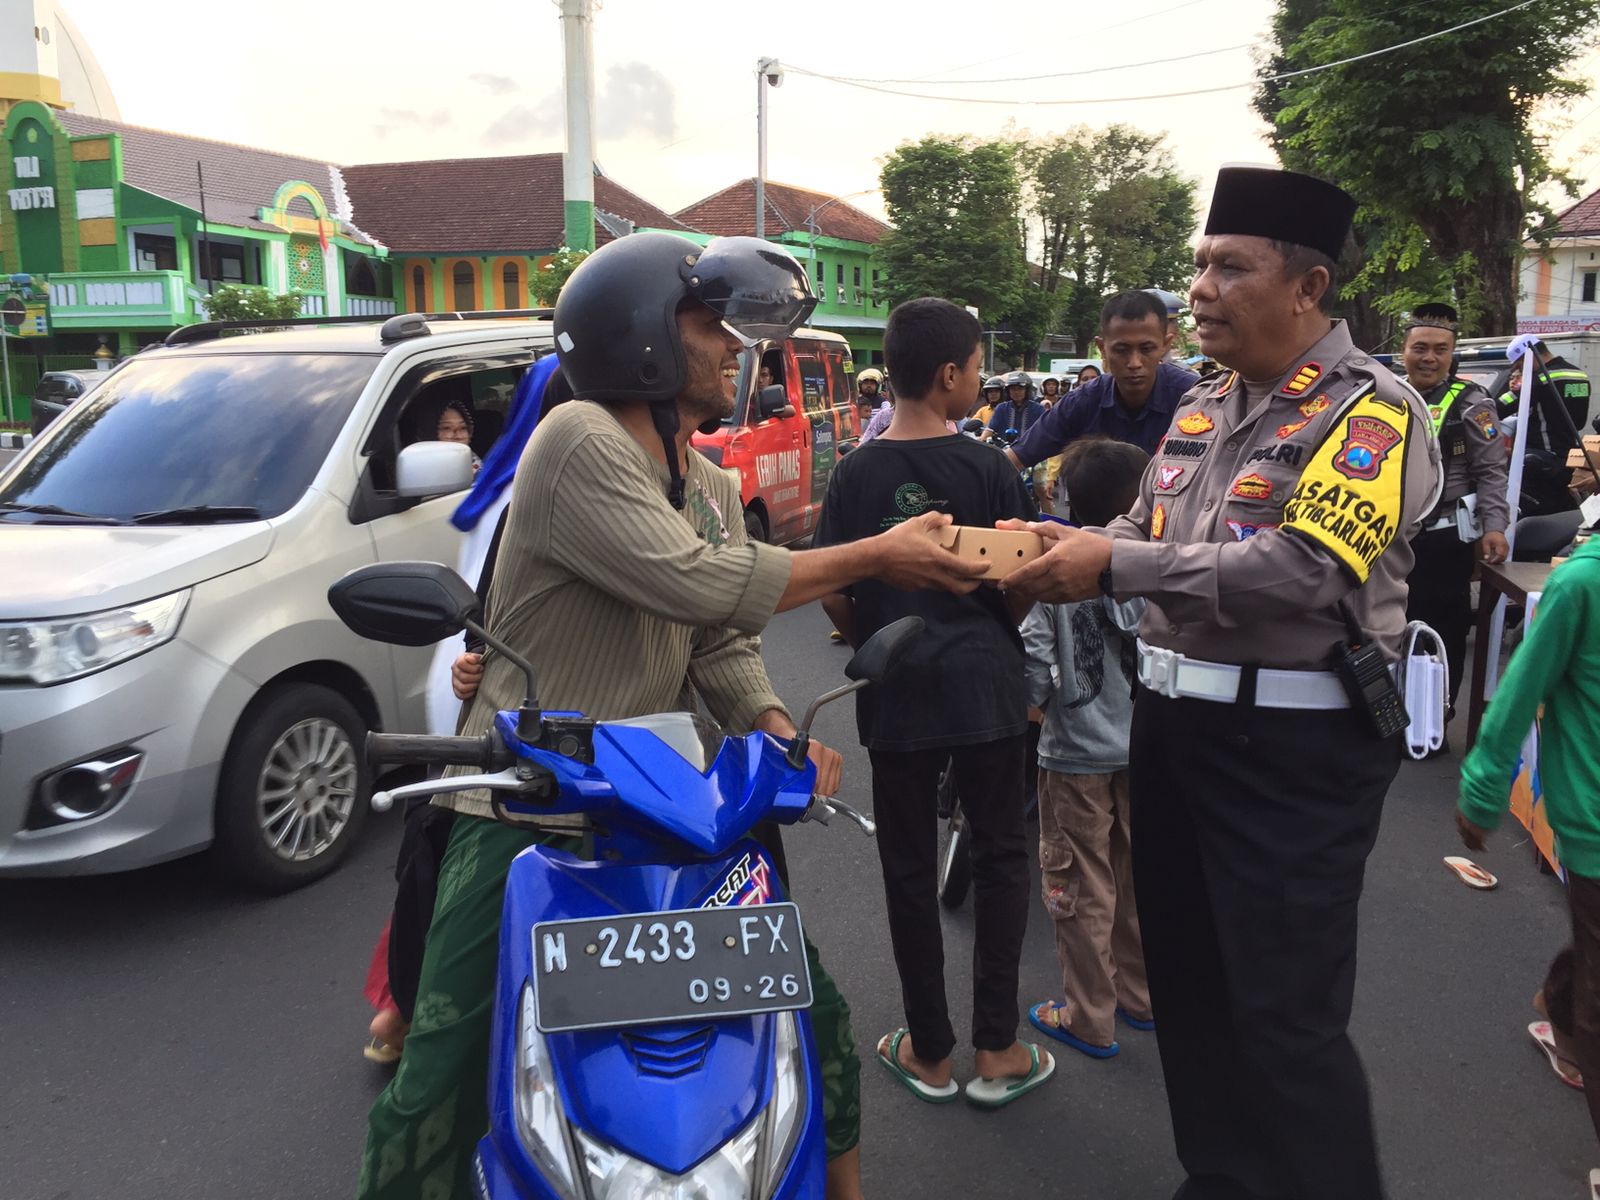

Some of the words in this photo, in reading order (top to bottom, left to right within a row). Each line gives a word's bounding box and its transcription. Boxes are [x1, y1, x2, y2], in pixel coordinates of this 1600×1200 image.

[755, 453, 778, 488] LEBIH
[779, 449, 800, 483] PANAS
[543, 932, 568, 973] N
[598, 920, 697, 968] 2433
[739, 914, 789, 955] FX
